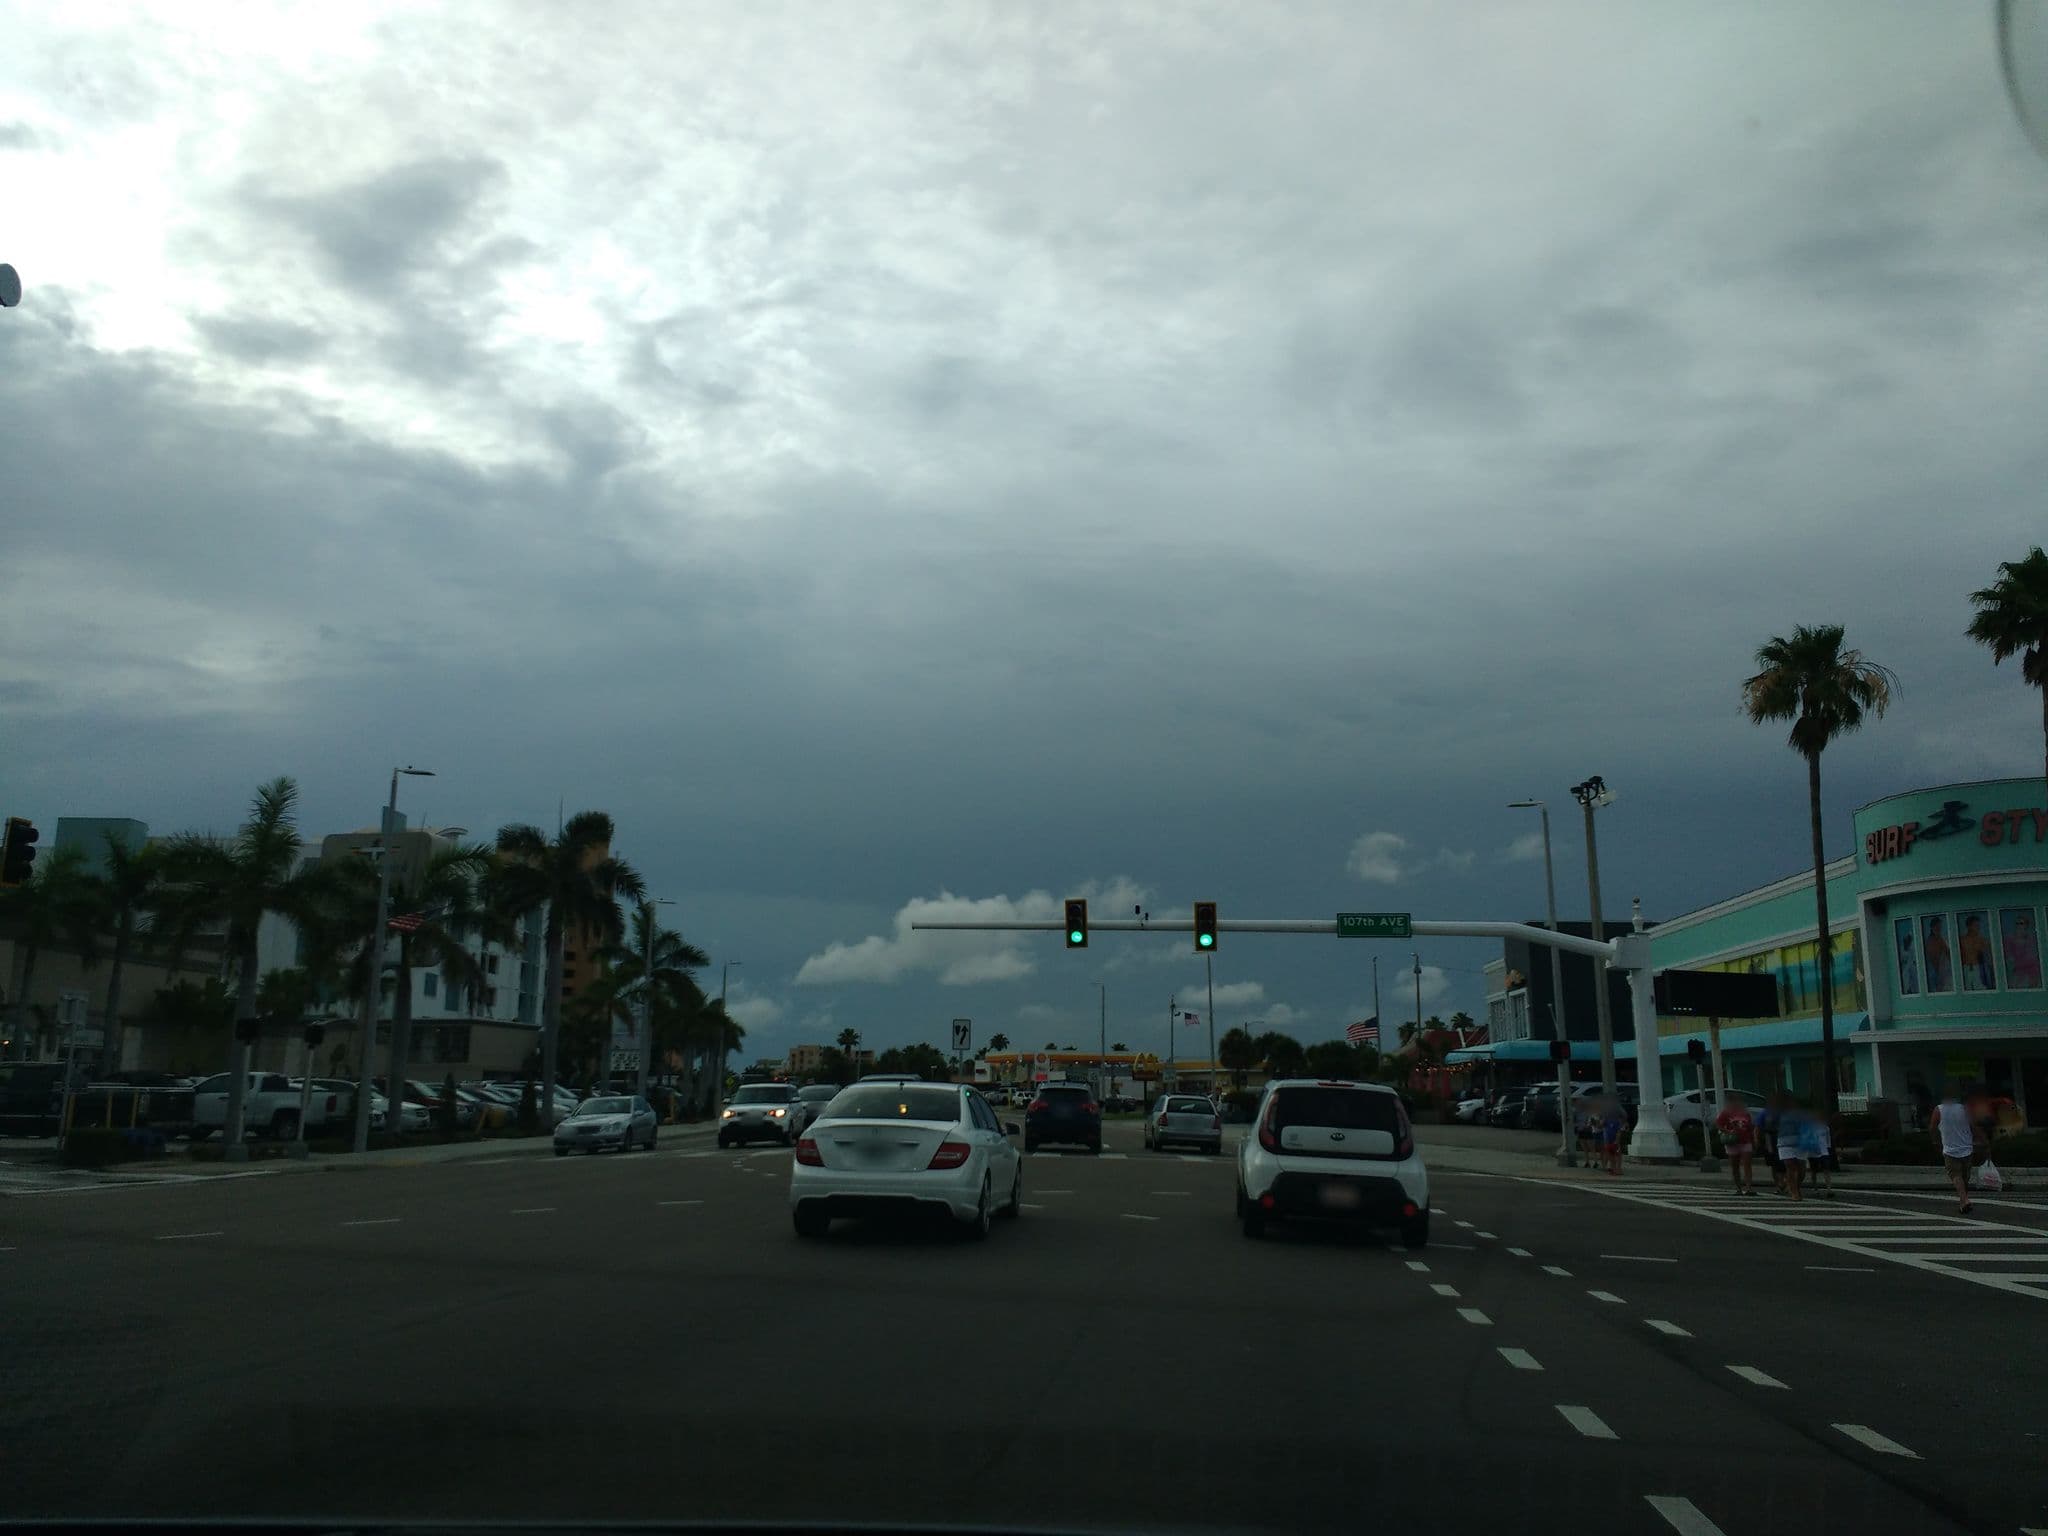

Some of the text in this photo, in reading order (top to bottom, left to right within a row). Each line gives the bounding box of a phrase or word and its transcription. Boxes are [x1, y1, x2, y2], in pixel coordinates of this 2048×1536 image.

[1866, 822, 1919, 864] SURF
[1343, 916, 1406, 927] 107th AVE
